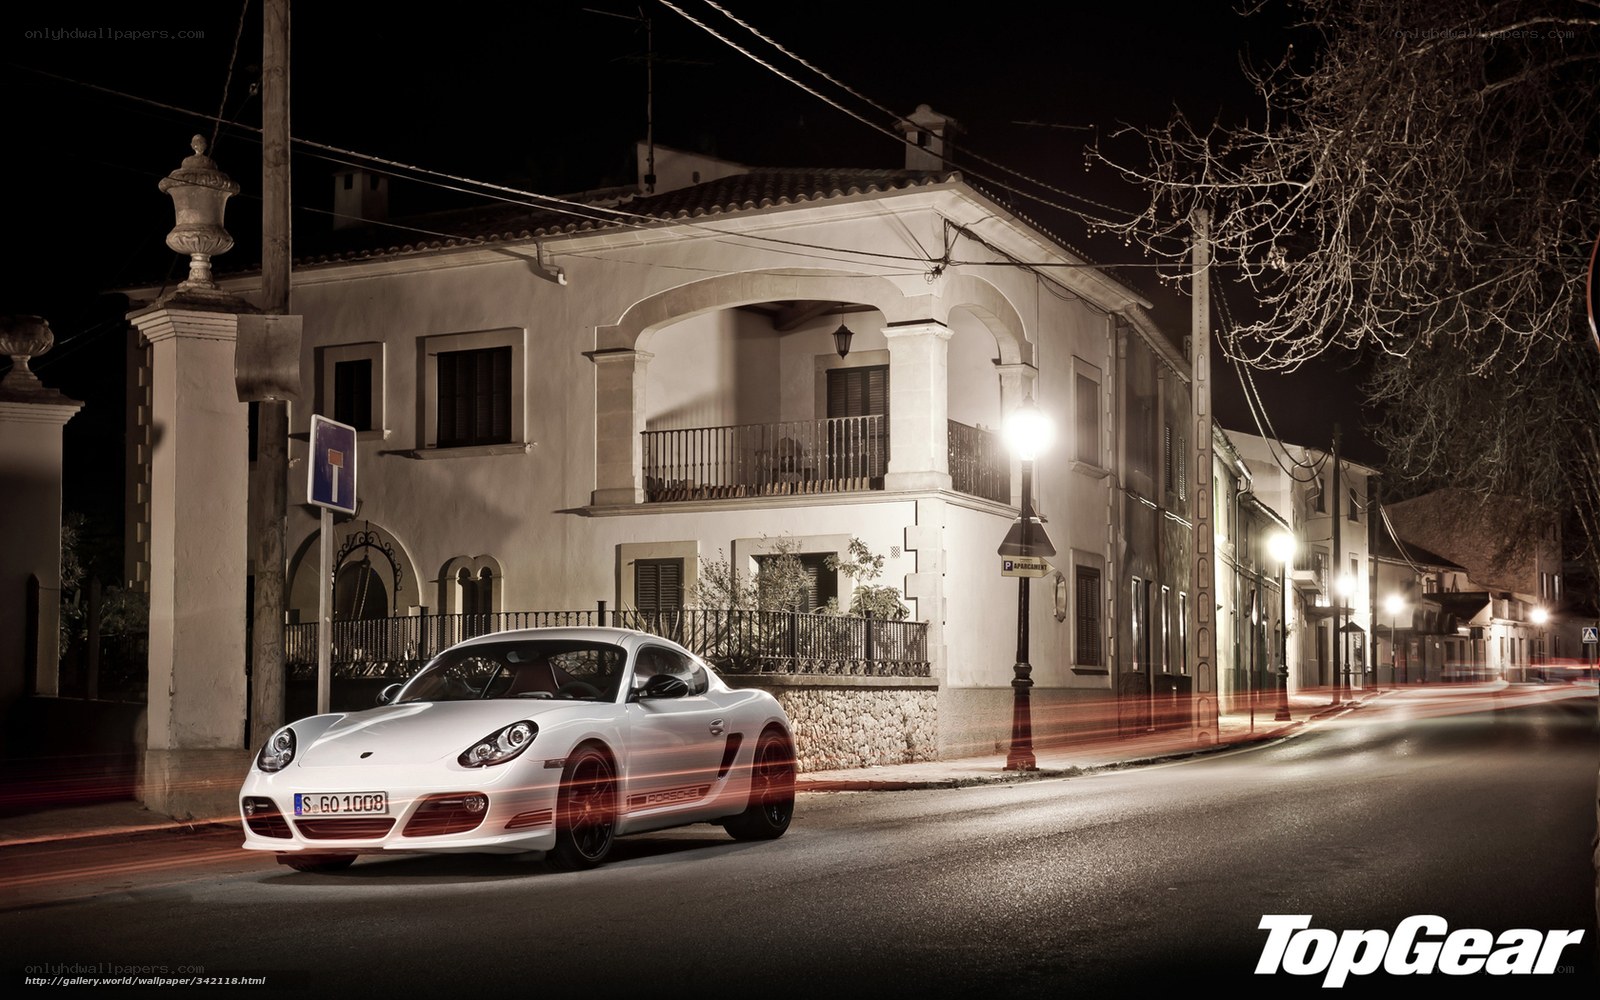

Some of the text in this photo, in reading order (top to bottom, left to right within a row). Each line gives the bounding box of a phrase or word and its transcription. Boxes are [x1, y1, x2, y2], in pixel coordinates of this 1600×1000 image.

[303, 794, 383, 812] S GO 1008
[648, 788, 697, 803] PORSCHE
